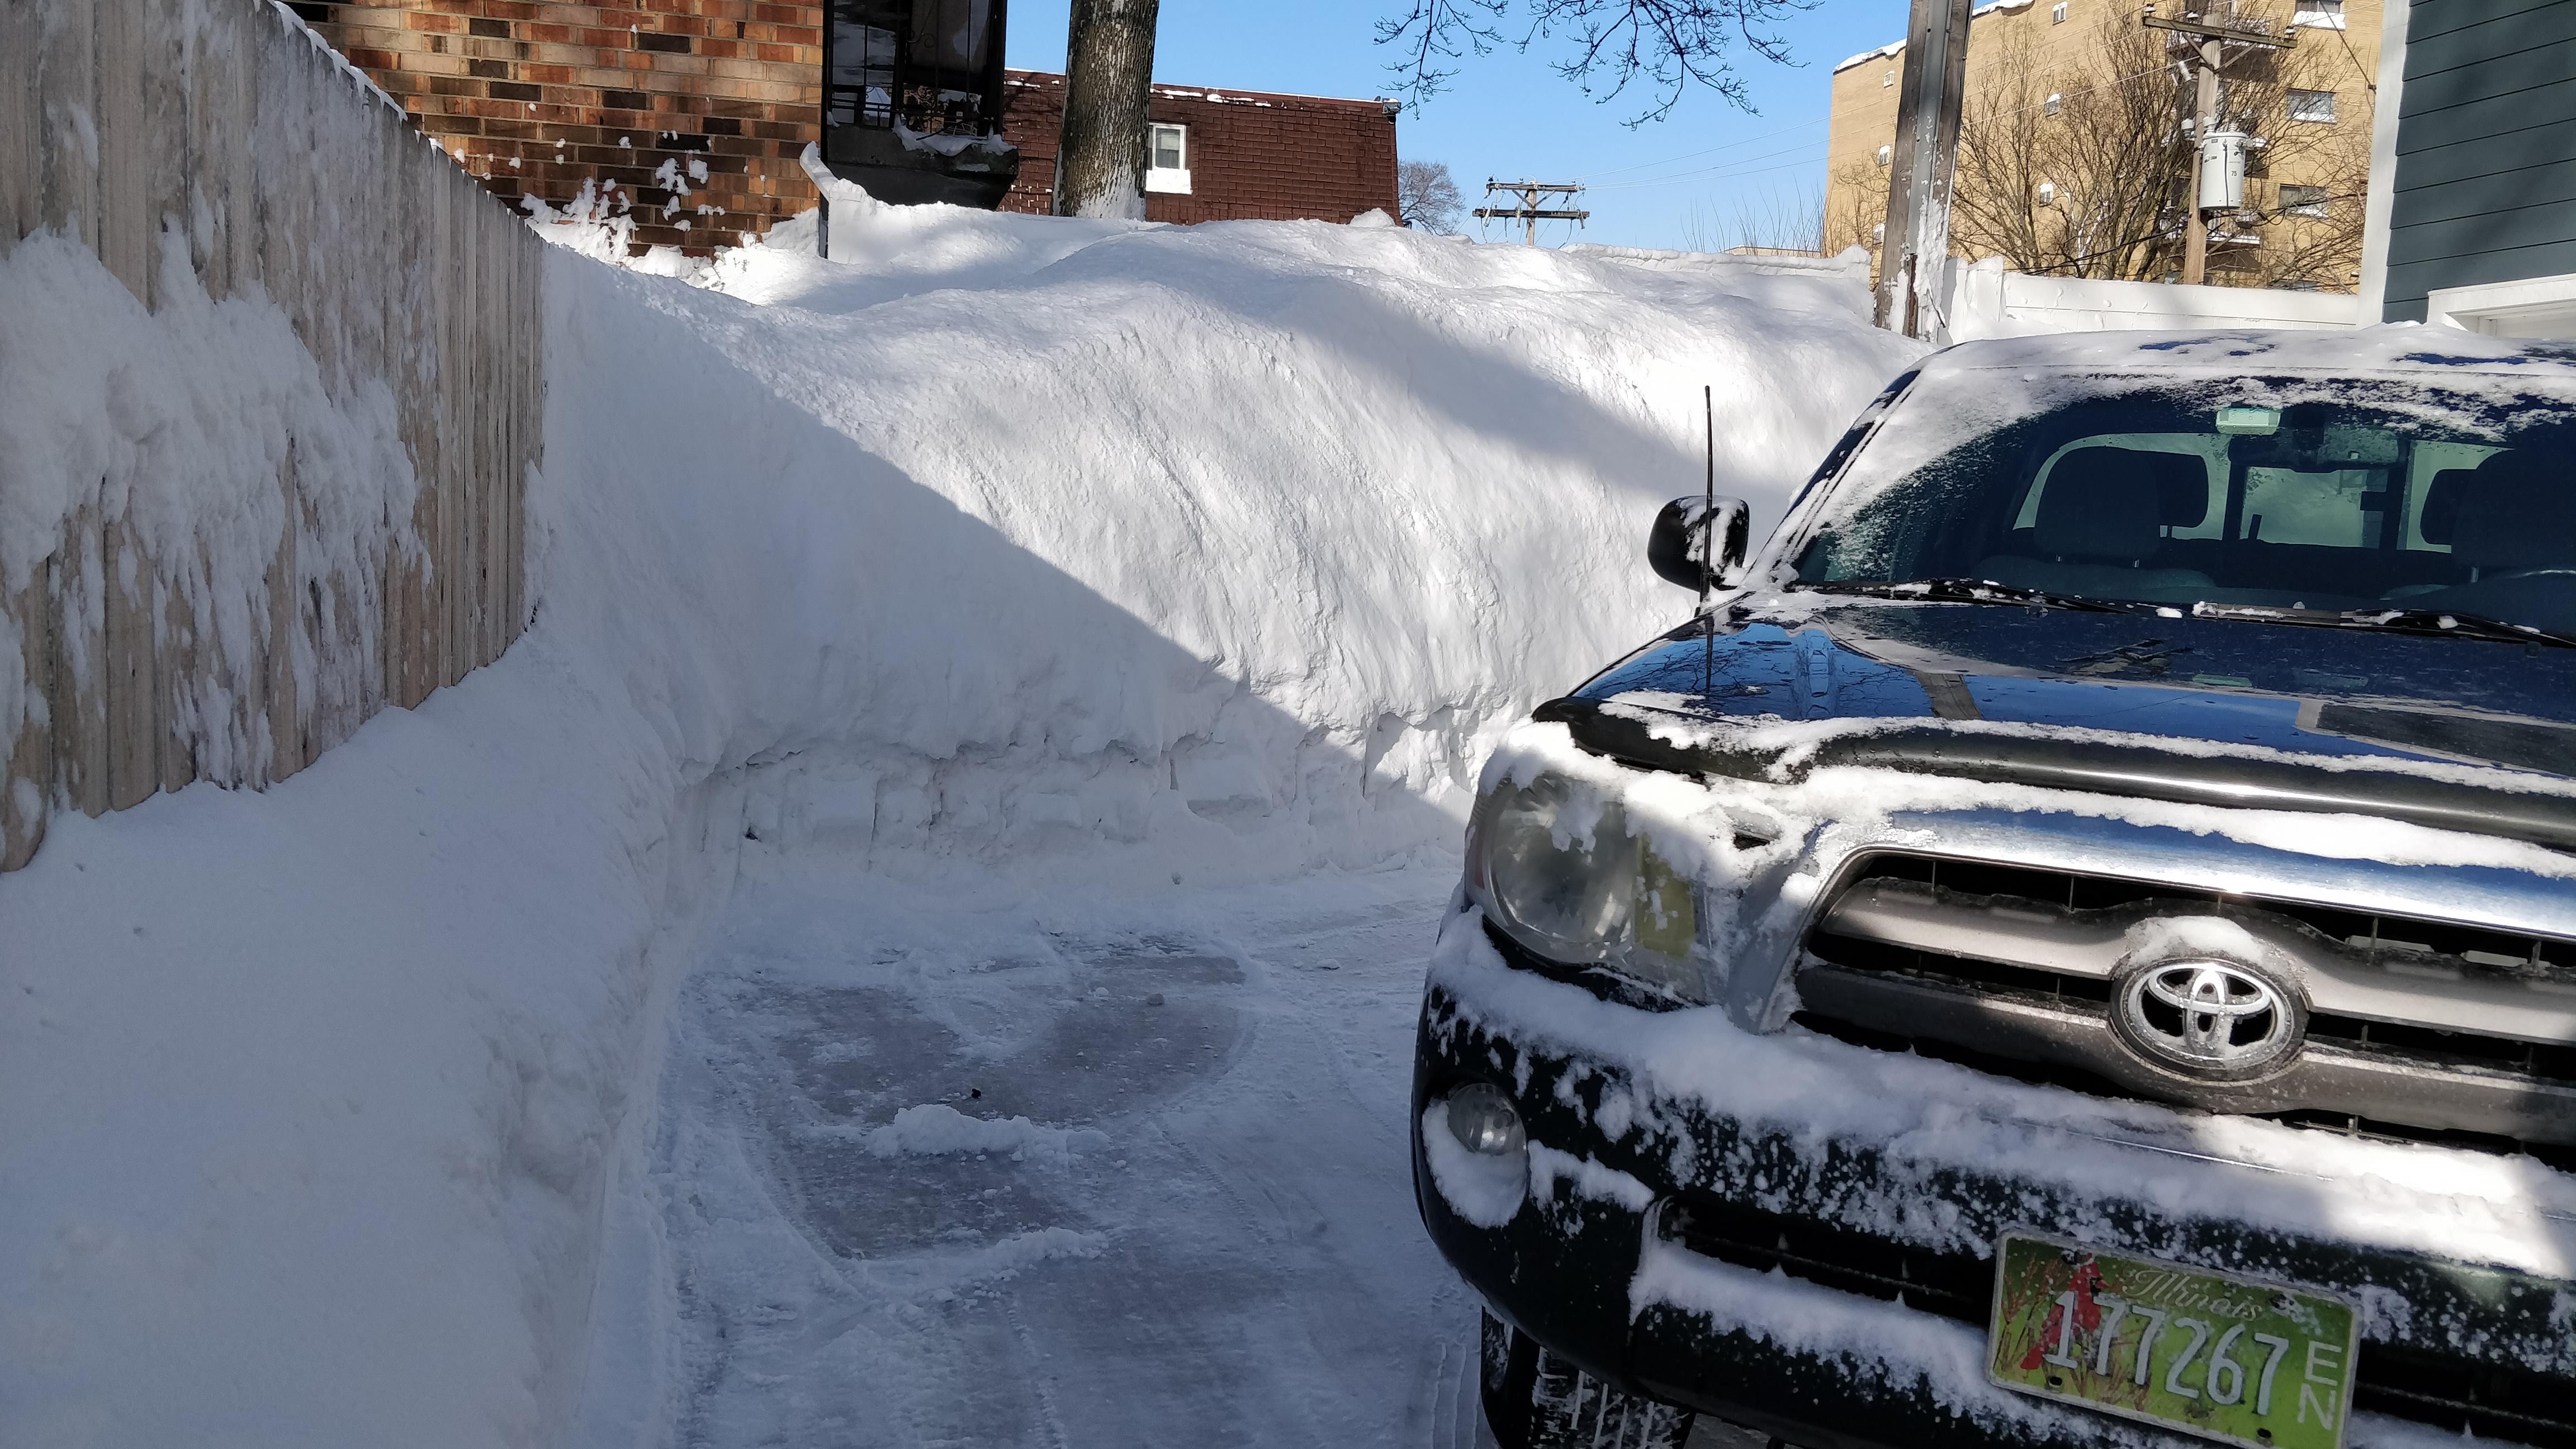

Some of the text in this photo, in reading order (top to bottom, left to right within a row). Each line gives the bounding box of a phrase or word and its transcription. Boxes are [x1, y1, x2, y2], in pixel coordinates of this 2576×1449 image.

[2122, 1270, 2263, 1321] Illinois
[2042, 1290, 2289, 1415] 177267
[2298, 1341, 2342, 1431] EN
